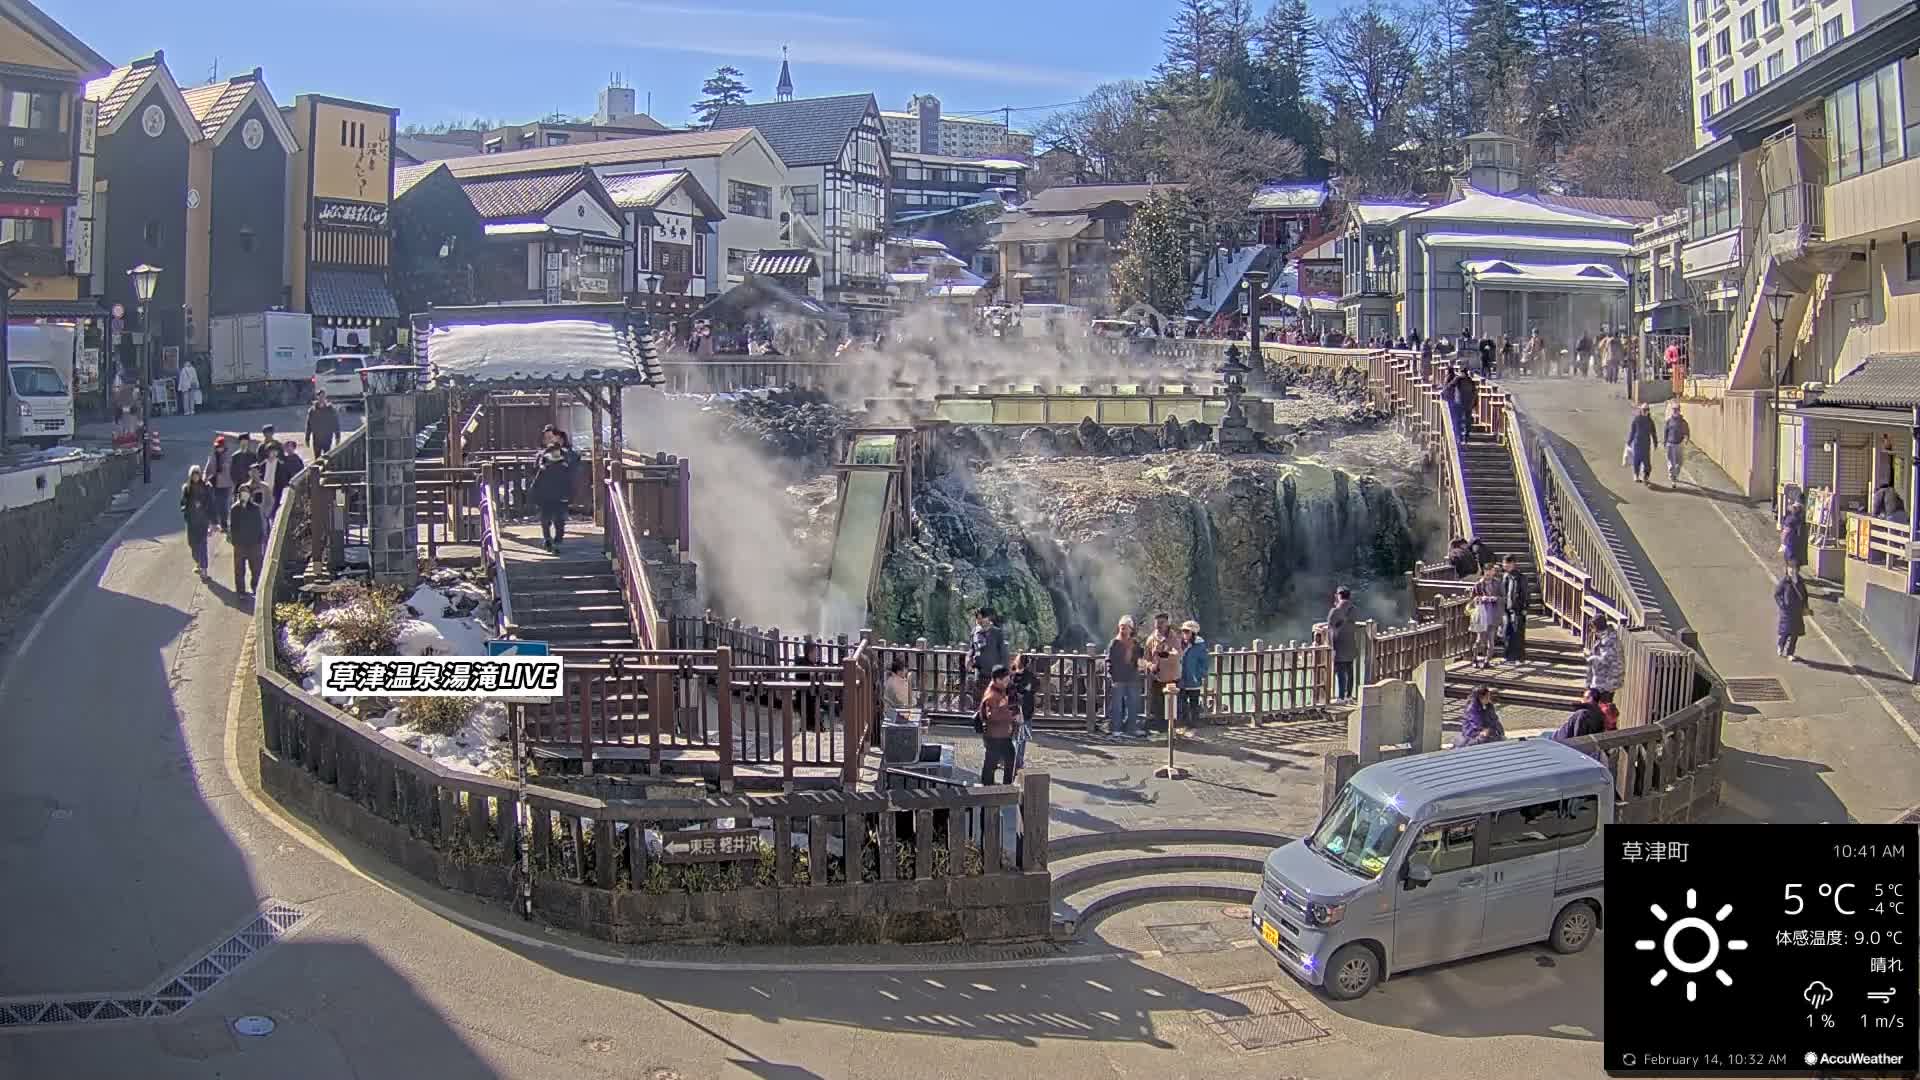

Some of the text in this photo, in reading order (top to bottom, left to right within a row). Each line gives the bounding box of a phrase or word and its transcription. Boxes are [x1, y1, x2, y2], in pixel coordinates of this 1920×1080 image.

[690, 835, 760, 856] 東京 軽井沢
